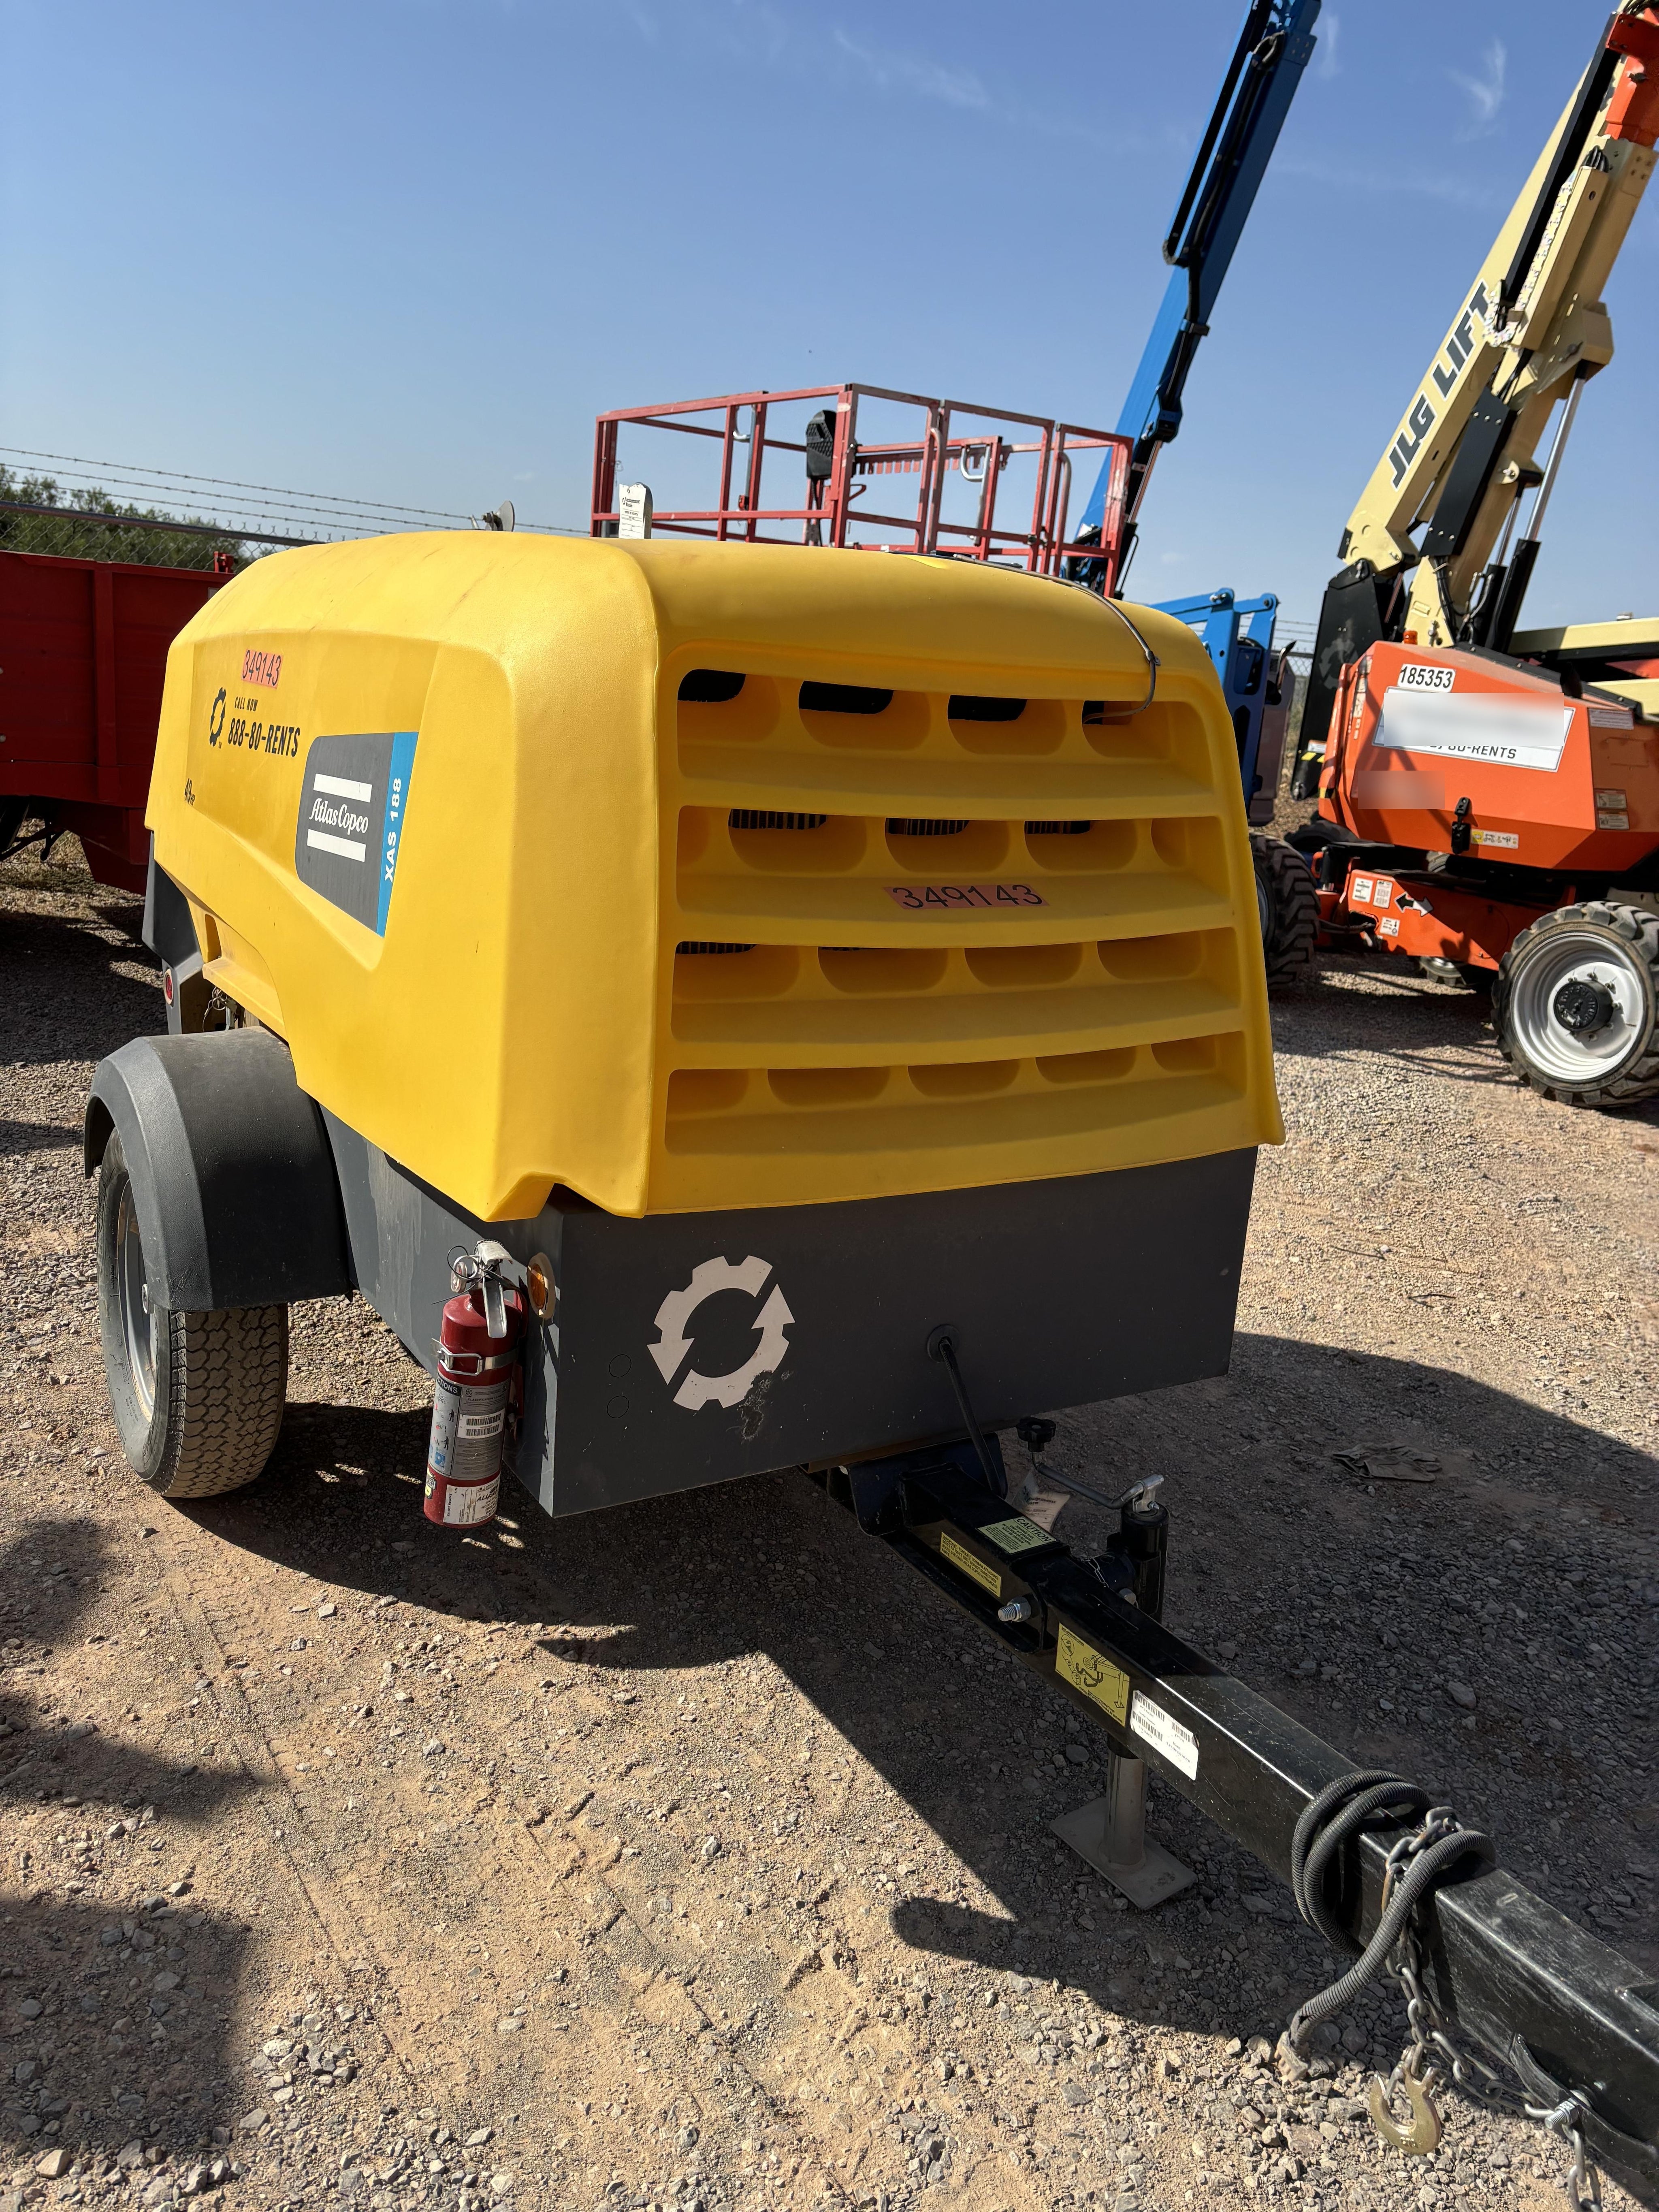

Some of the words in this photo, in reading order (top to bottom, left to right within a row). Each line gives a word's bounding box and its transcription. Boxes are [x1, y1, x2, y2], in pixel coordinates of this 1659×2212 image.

[1388, 392, 1437, 490] JLG
[1431, 280, 1488, 399] LIFT
[242, 650, 281, 686] 349143
[1401, 666, 1453, 688] 185353
[235, 697, 245, 709] CALL
[247, 698, 258, 711] NOW
[228, 718, 300, 757] 888-80-RENTS
[390, 778, 401, 821] 188
[385, 832, 397, 883] XAS
[893, 884, 1043, 908] 349143
[1017, 1519, 1051, 1542] CAUTION
